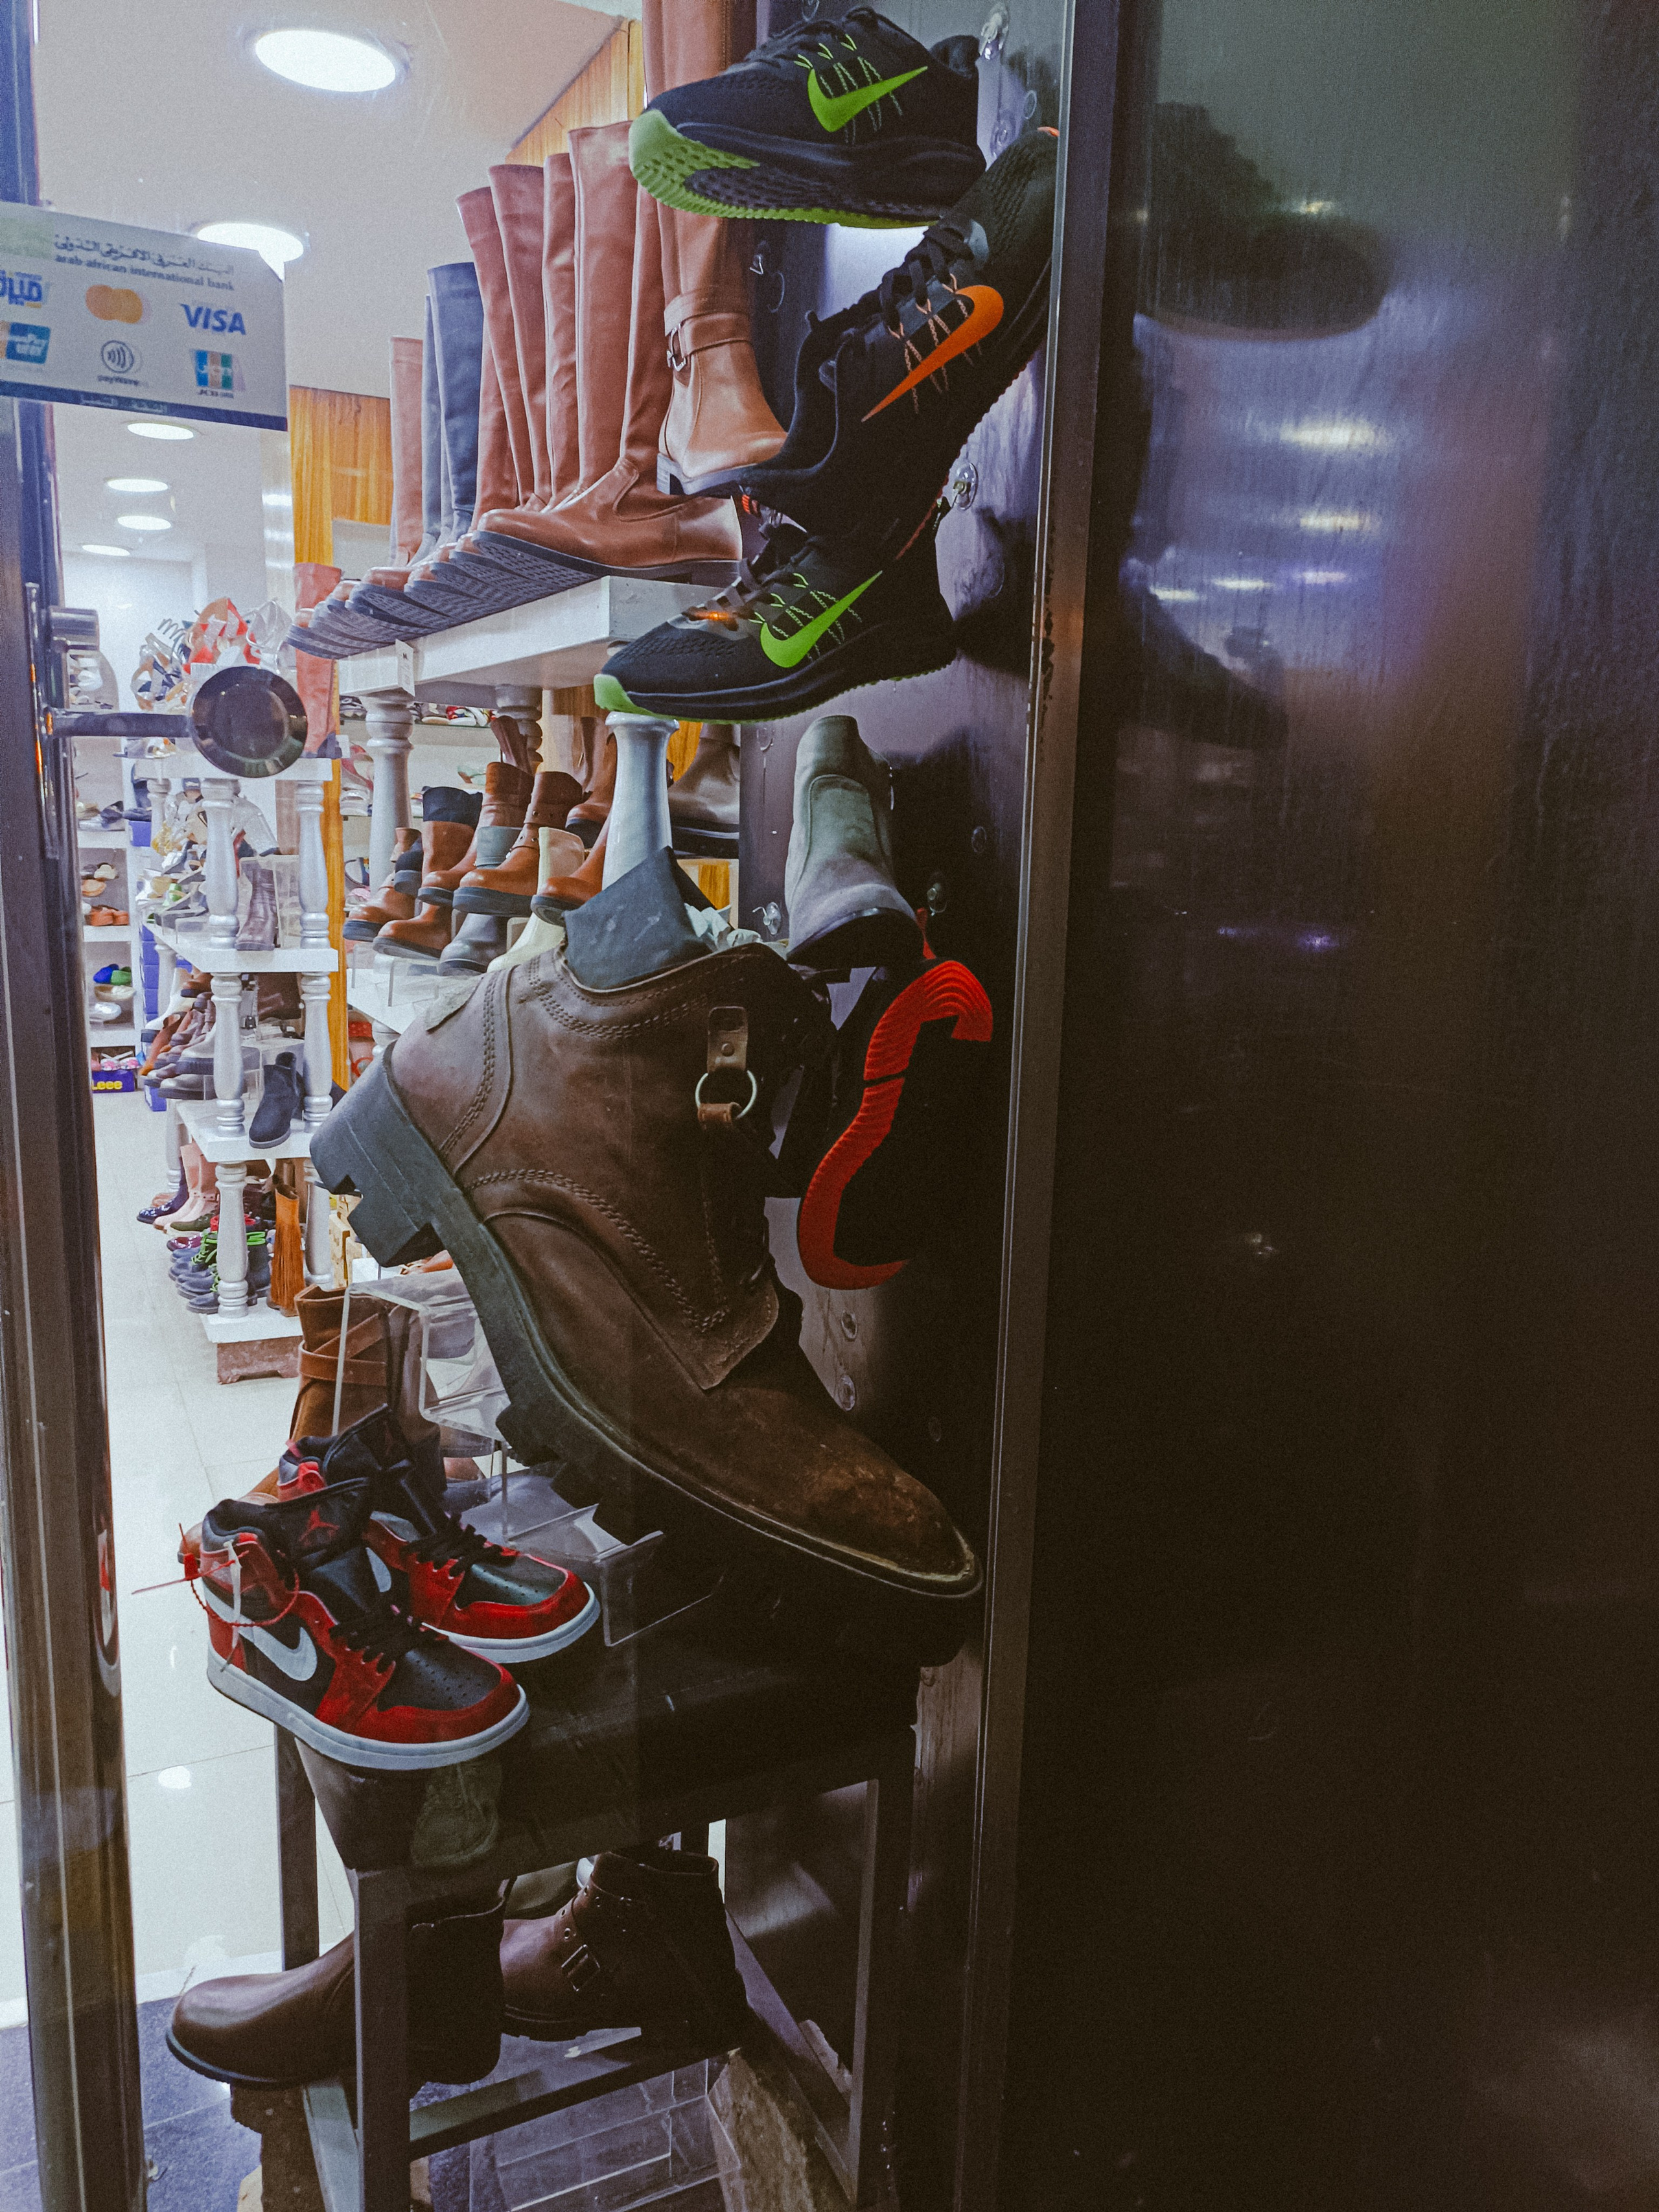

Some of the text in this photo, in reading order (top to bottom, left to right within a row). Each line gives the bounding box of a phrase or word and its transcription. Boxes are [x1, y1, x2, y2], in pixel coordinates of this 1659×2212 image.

[130, 264, 204, 286] international
[207, 277, 235, 291] bank
[180, 303, 246, 335] VISA
